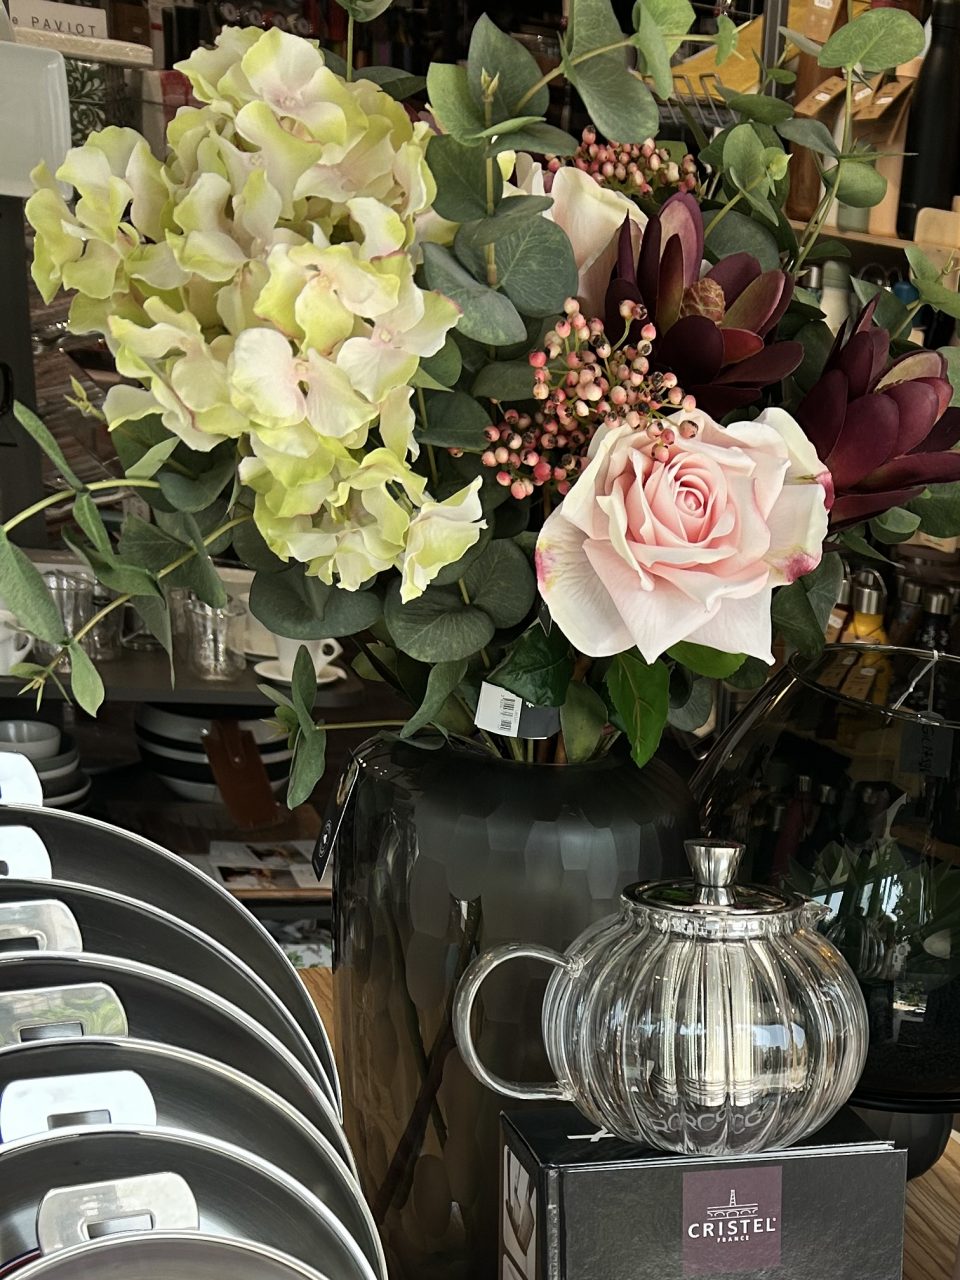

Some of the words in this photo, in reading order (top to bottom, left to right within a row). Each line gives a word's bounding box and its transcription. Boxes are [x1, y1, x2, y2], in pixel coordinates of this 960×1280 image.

[31, 16, 97, 36] PAVIOT
[688, 1218, 776, 1239] CRISTEL
[717, 1235, 749, 1243] FRANCE
